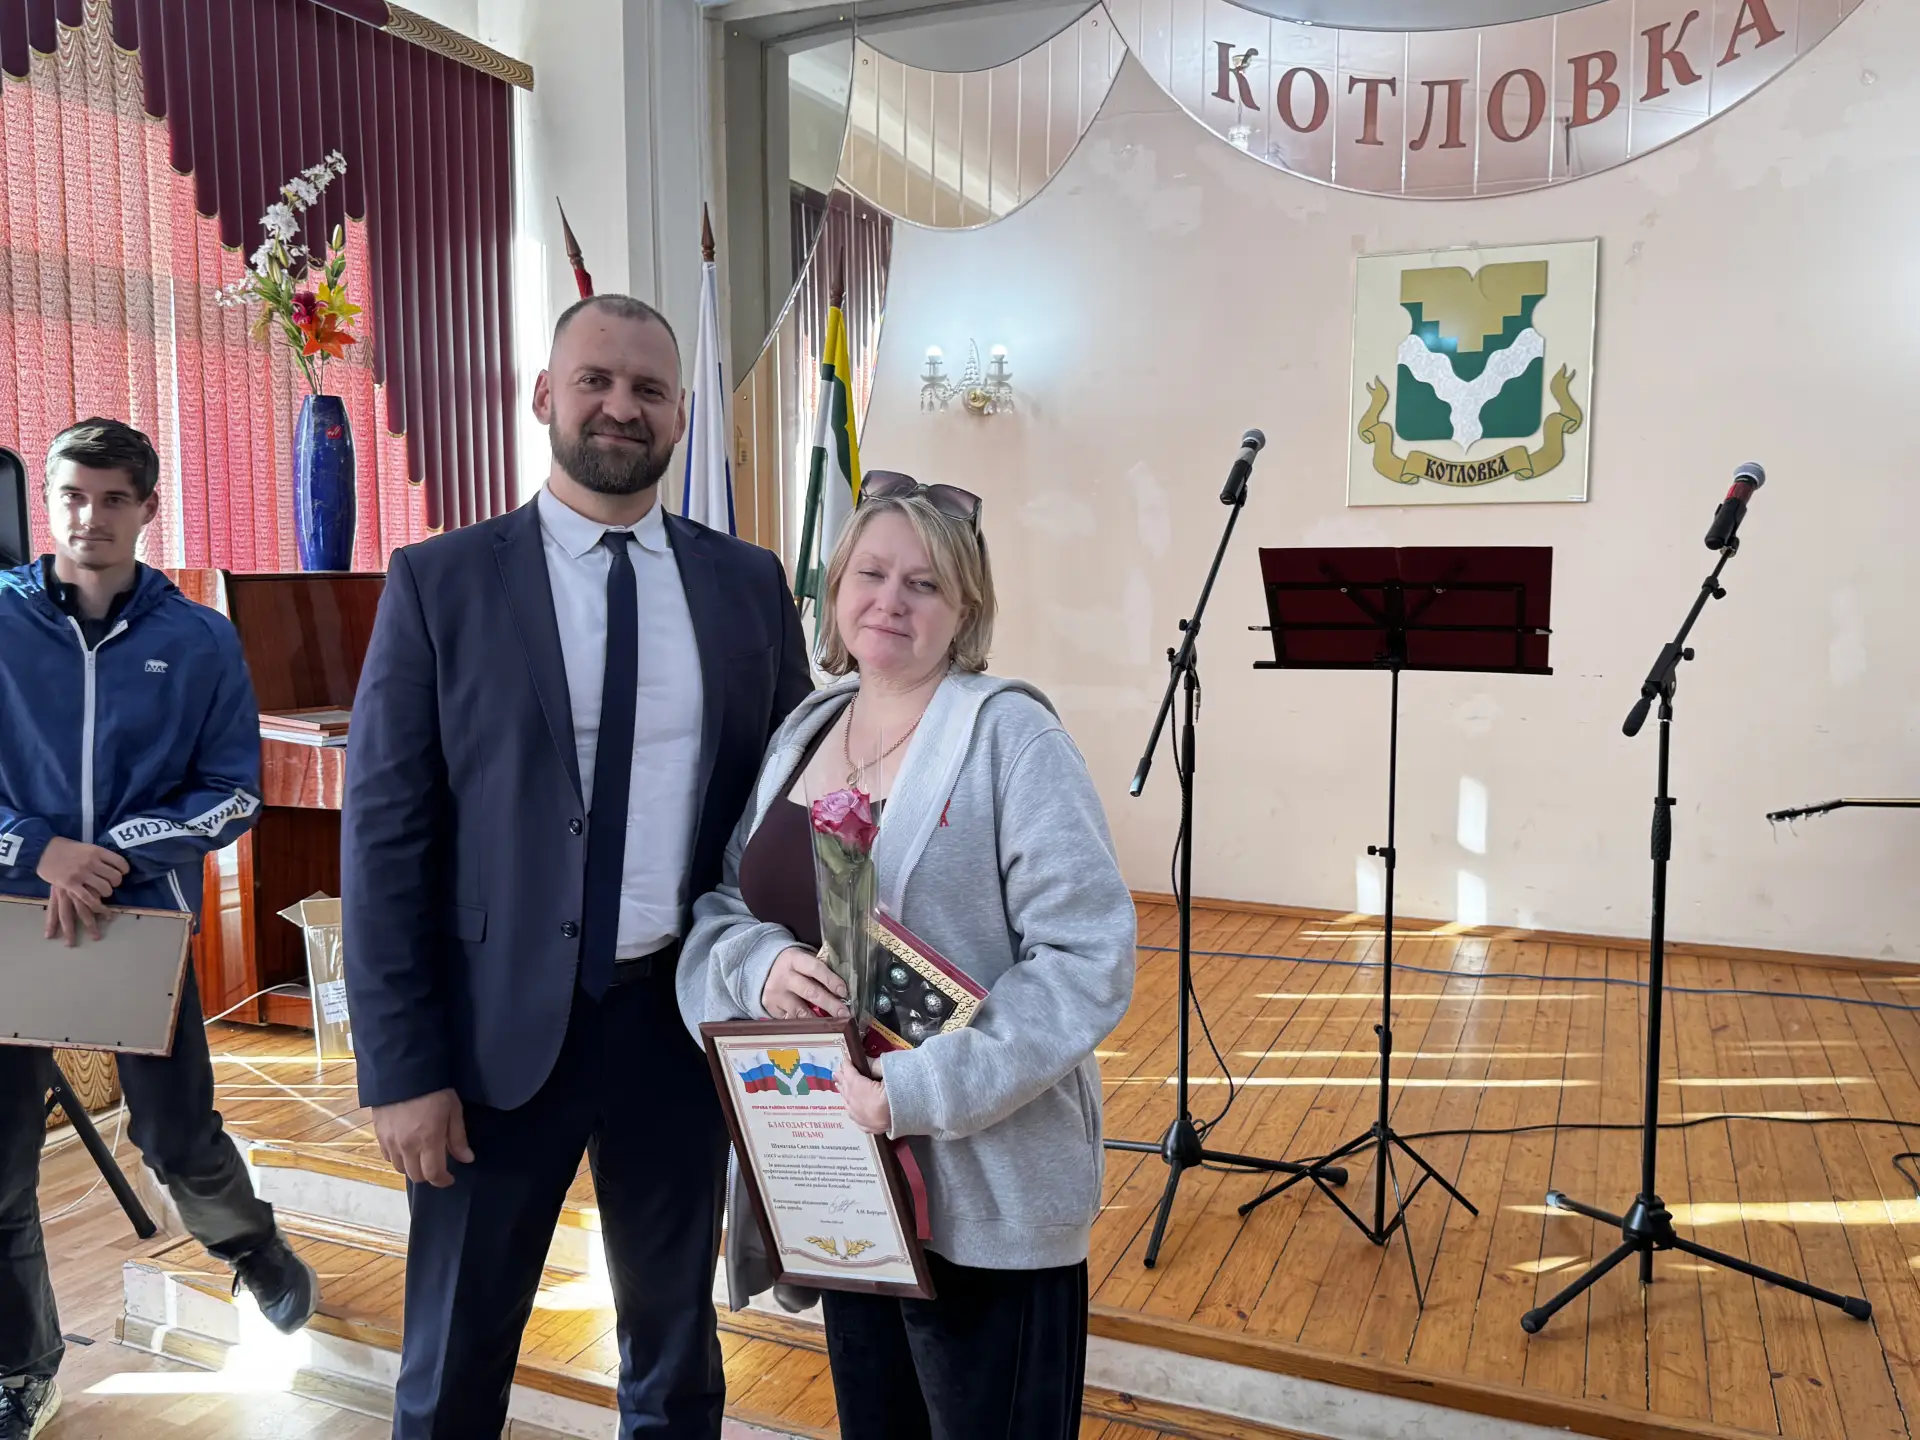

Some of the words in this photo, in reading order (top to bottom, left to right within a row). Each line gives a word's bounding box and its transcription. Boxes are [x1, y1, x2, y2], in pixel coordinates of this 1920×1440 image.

[1211, 0, 1785, 151] КОТЛОВКА
[1424, 455, 1509, 484] КОТЛОВКА
[768, 1121, 844, 1129] БЛАГОДАРСТВЕННОЕ
[792, 1130, 824, 1138] ПИСЬМО
